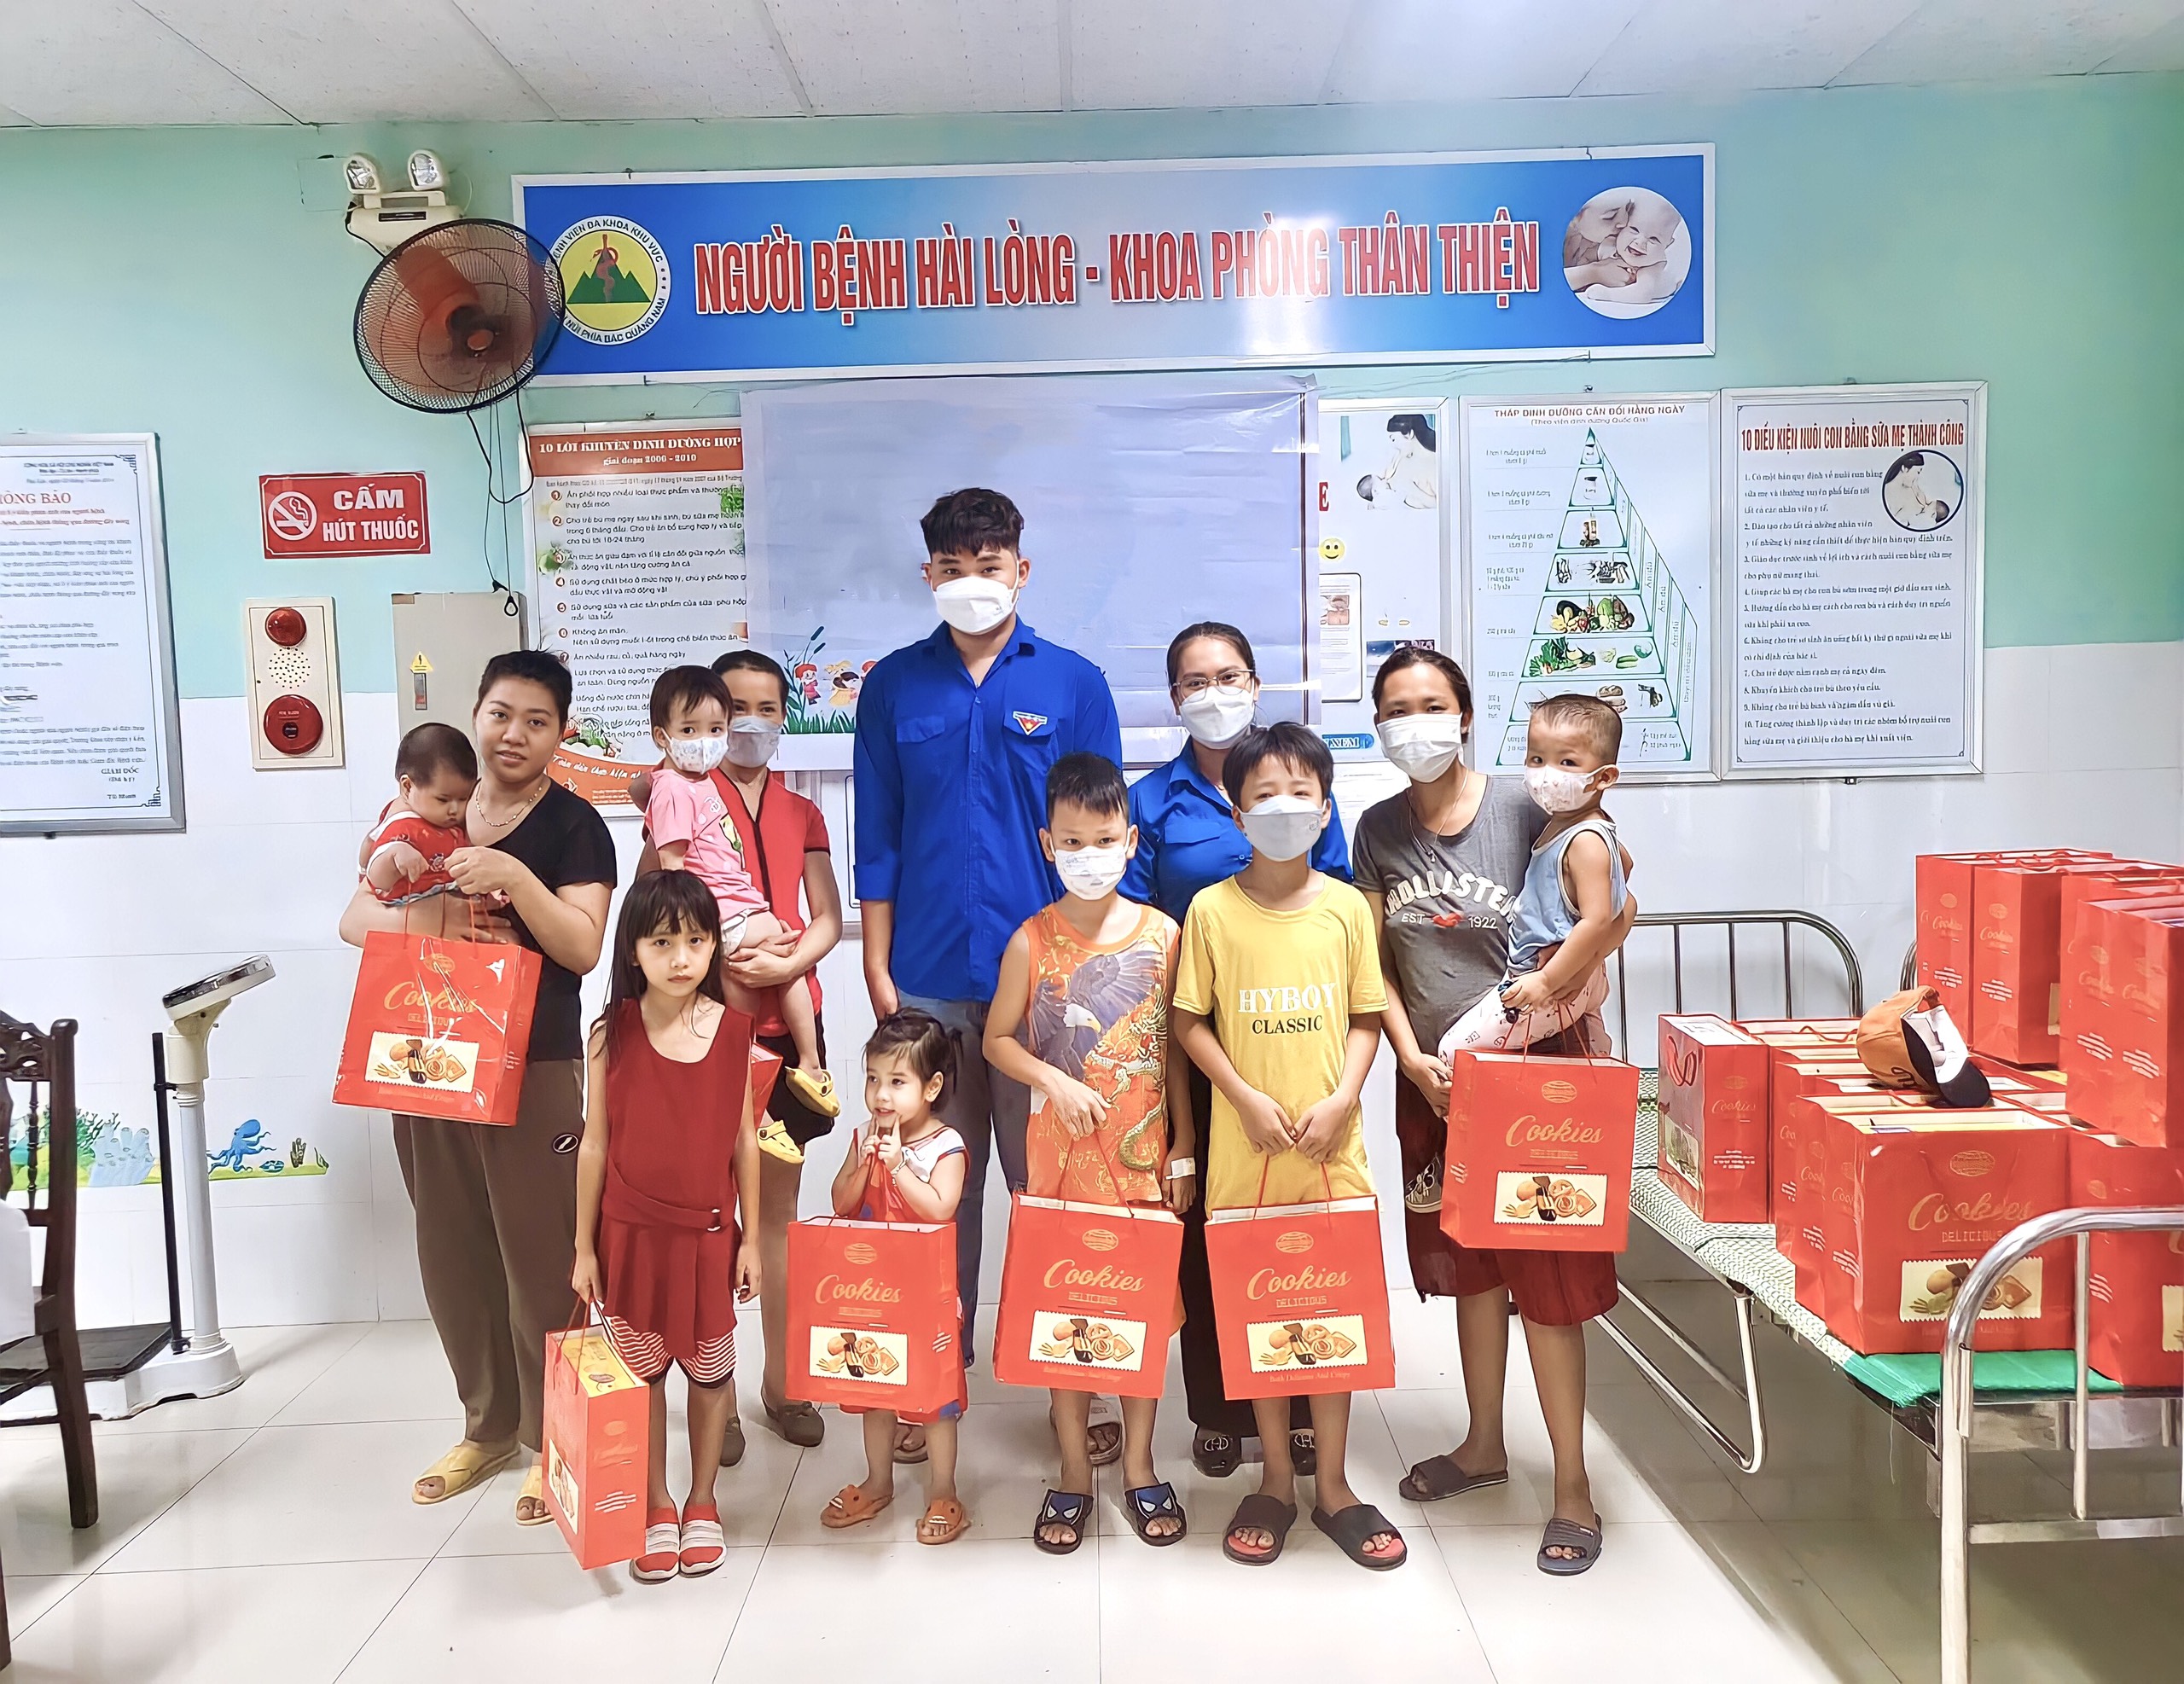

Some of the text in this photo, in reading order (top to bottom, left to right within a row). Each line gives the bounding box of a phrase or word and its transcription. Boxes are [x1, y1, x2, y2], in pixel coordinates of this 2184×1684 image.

[603, 218, 629, 231] KHOA
[630, 226, 649, 244] KHU
[694, 224, 805, 315] NGƯỜI
[811, 224, 909, 326] BỆNH
[915, 223, 975, 308] HÀI
[985, 218, 1076, 306] LÒNG
[1110, 231, 1202, 302] KHOA
[1211, 212, 1329, 301] PHÒNG
[1338, 211, 1430, 296] THÂN
[1437, 206, 1539, 309] THIỆN
[651, 298, 665, 317] NAM
[1548, 407, 1583, 416] DƯỠNG
[1629, 404, 1655, 415] HÀNG
[1658, 404, 1685, 414] NGÀY
[539, 444, 554, 453] 10
[633, 439, 665, 450] DINH
[1742, 429, 1751, 450] 10
[1777, 423, 1798, 455] KIỆN
[1800, 422, 1821, 450] NUÔI
[1824, 427, 1843, 449] CON
[1891, 425, 1905, 451] MẸ
[1908, 419, 1937, 446] THÀNH
[1939, 418, 1963, 445] CÔNG
[603, 456, 619, 466] giai
[334, 483, 404, 510] CẤM
[1319, 482, 1329, 512] E
[322, 514, 419, 542] HÚT THUỐC
[1402, 914, 1498, 929] EST 1922
[1238, 983, 1337, 1013] HYBOY
[1252, 1015, 1322, 1034] CLASSIC
[1506, 1115, 1604, 1147] Cookies
[1908, 1193, 2031, 1231] Cookies
[815, 1275, 903, 1304] Cookies
[1043, 1259, 1146, 1292] Cookies
[1246, 1266, 1352, 1300] Cookies
[1276, 1296, 1327, 1308] DELICIOUS
